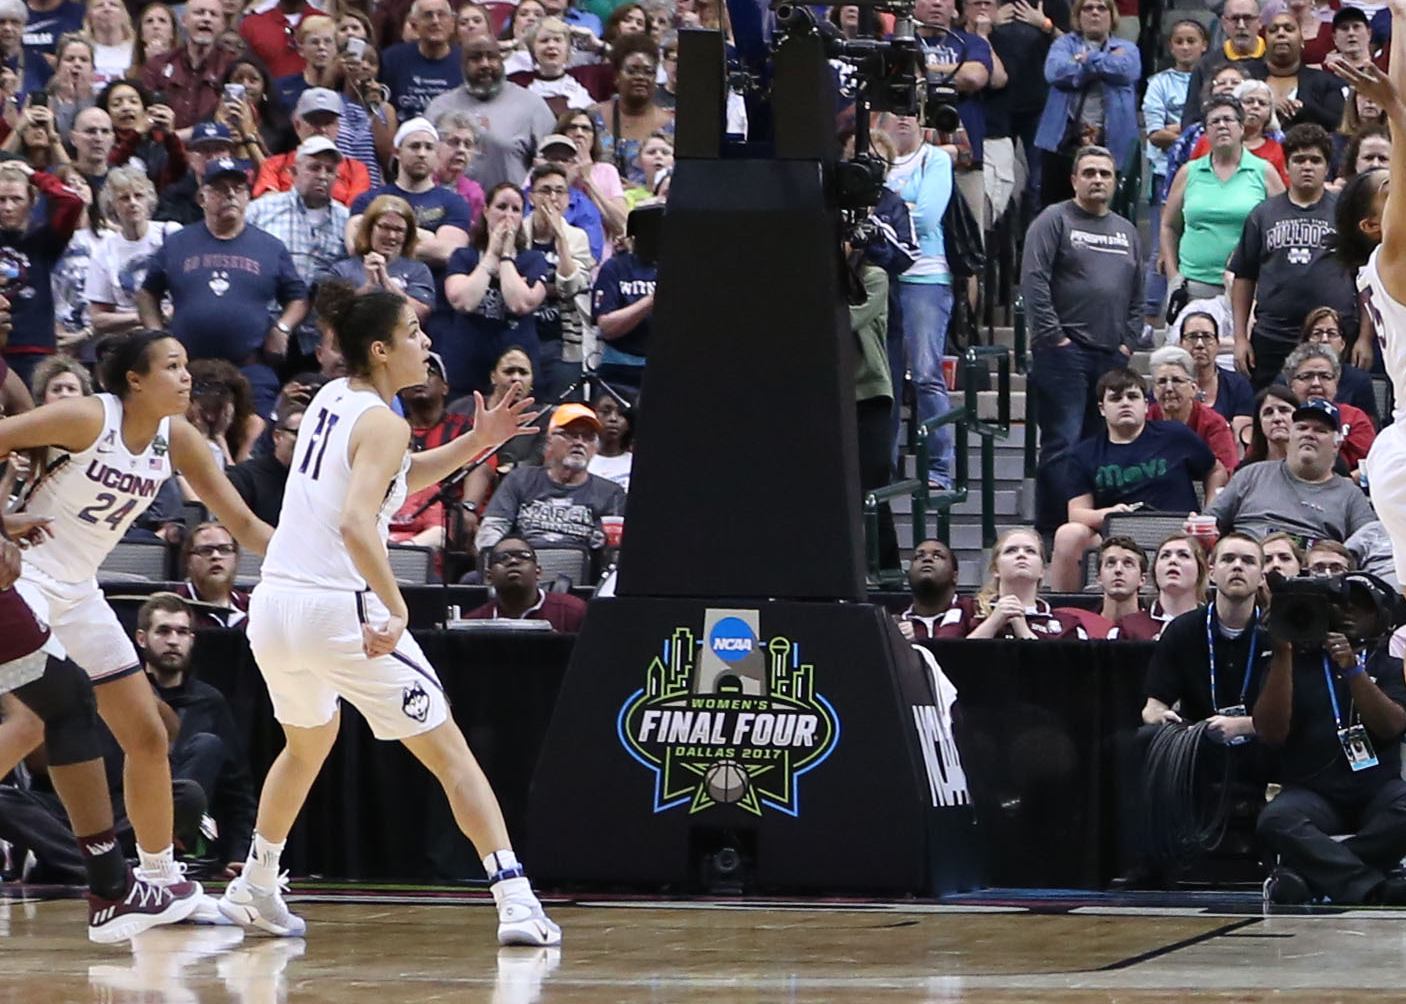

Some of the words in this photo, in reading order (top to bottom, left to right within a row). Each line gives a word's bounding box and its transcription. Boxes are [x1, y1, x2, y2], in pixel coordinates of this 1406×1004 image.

[299, 407, 340, 481] 11
[86, 459, 159, 498] UCONN
[78, 493, 139, 531] 24
[712, 638, 752, 652] NCAA
[691, 698, 768, 710] WOMEN'S
[638, 710, 727, 745] FINAL
[732, 712, 818, 747] FOUR
[675, 747, 735, 758] DALLAS
[742, 748, 782, 759] 2017
